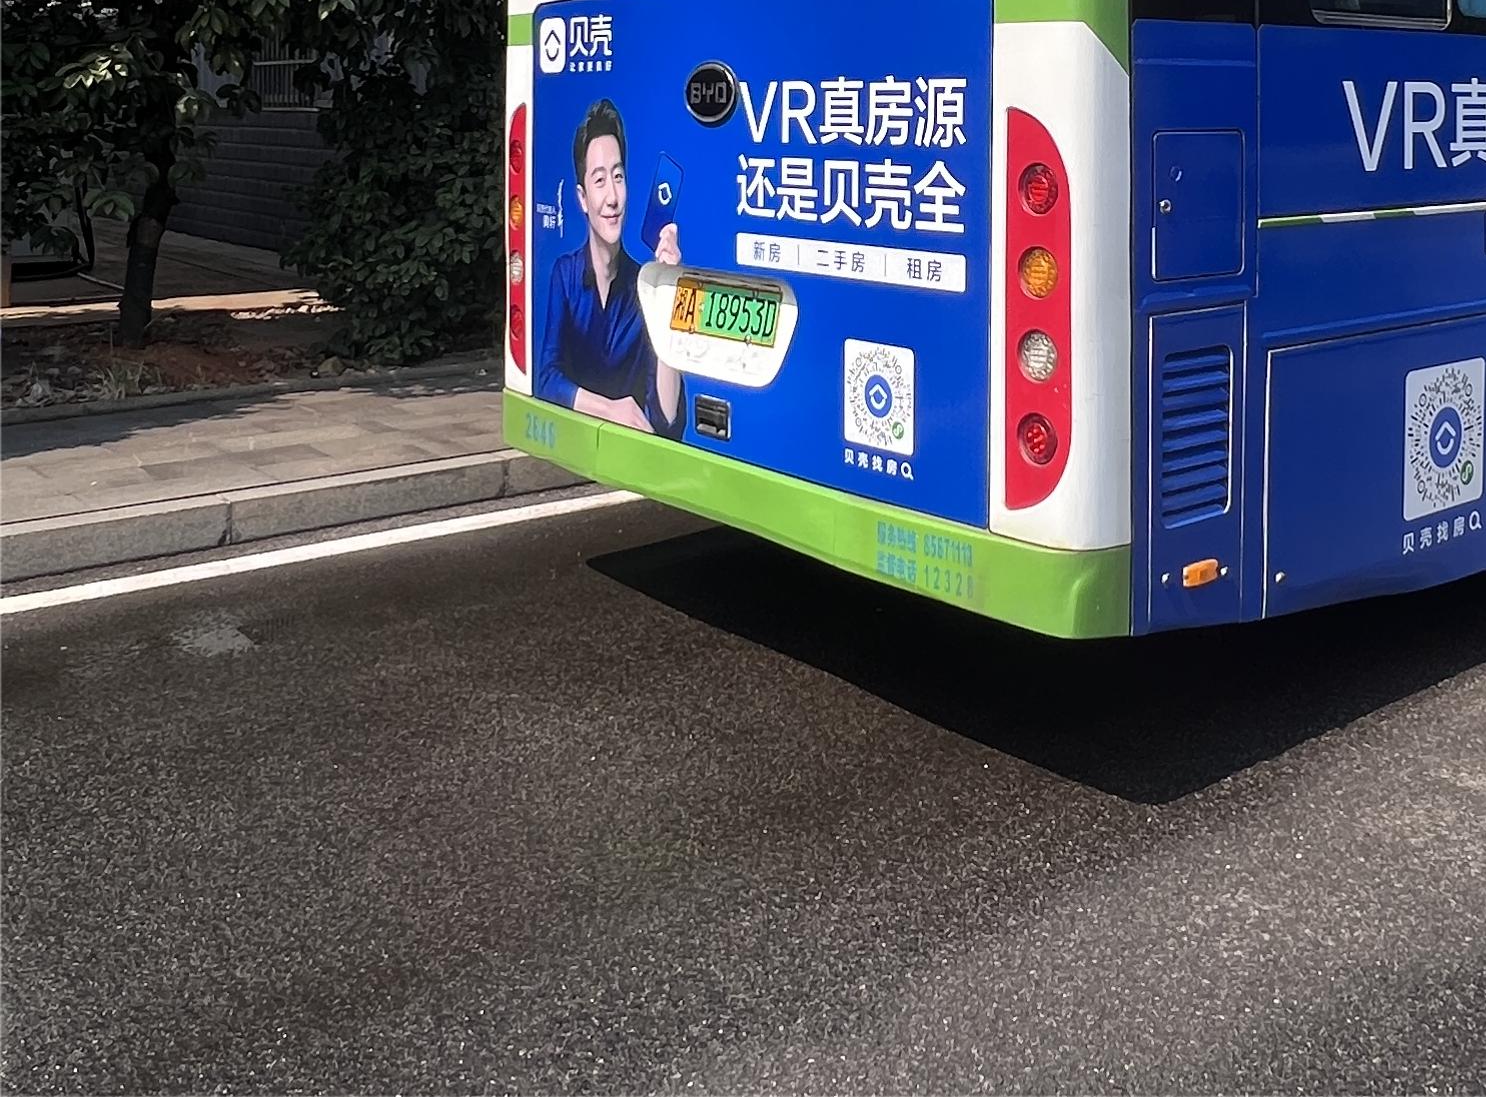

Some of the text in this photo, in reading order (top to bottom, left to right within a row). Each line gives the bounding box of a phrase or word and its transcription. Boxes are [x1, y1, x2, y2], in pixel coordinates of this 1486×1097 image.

[570, 14, 613, 57] 贝壳
[690, 81, 727, 105] BYD
[739, 75, 968, 148] VR真房源
[736, 153, 967, 234] 还是贝壳全
[753, 241, 943, 282] 新房 二手房 租房
[844, 448, 898, 477] 贝壳找房
[1402, 516, 1465, 556] 贝壳找房
